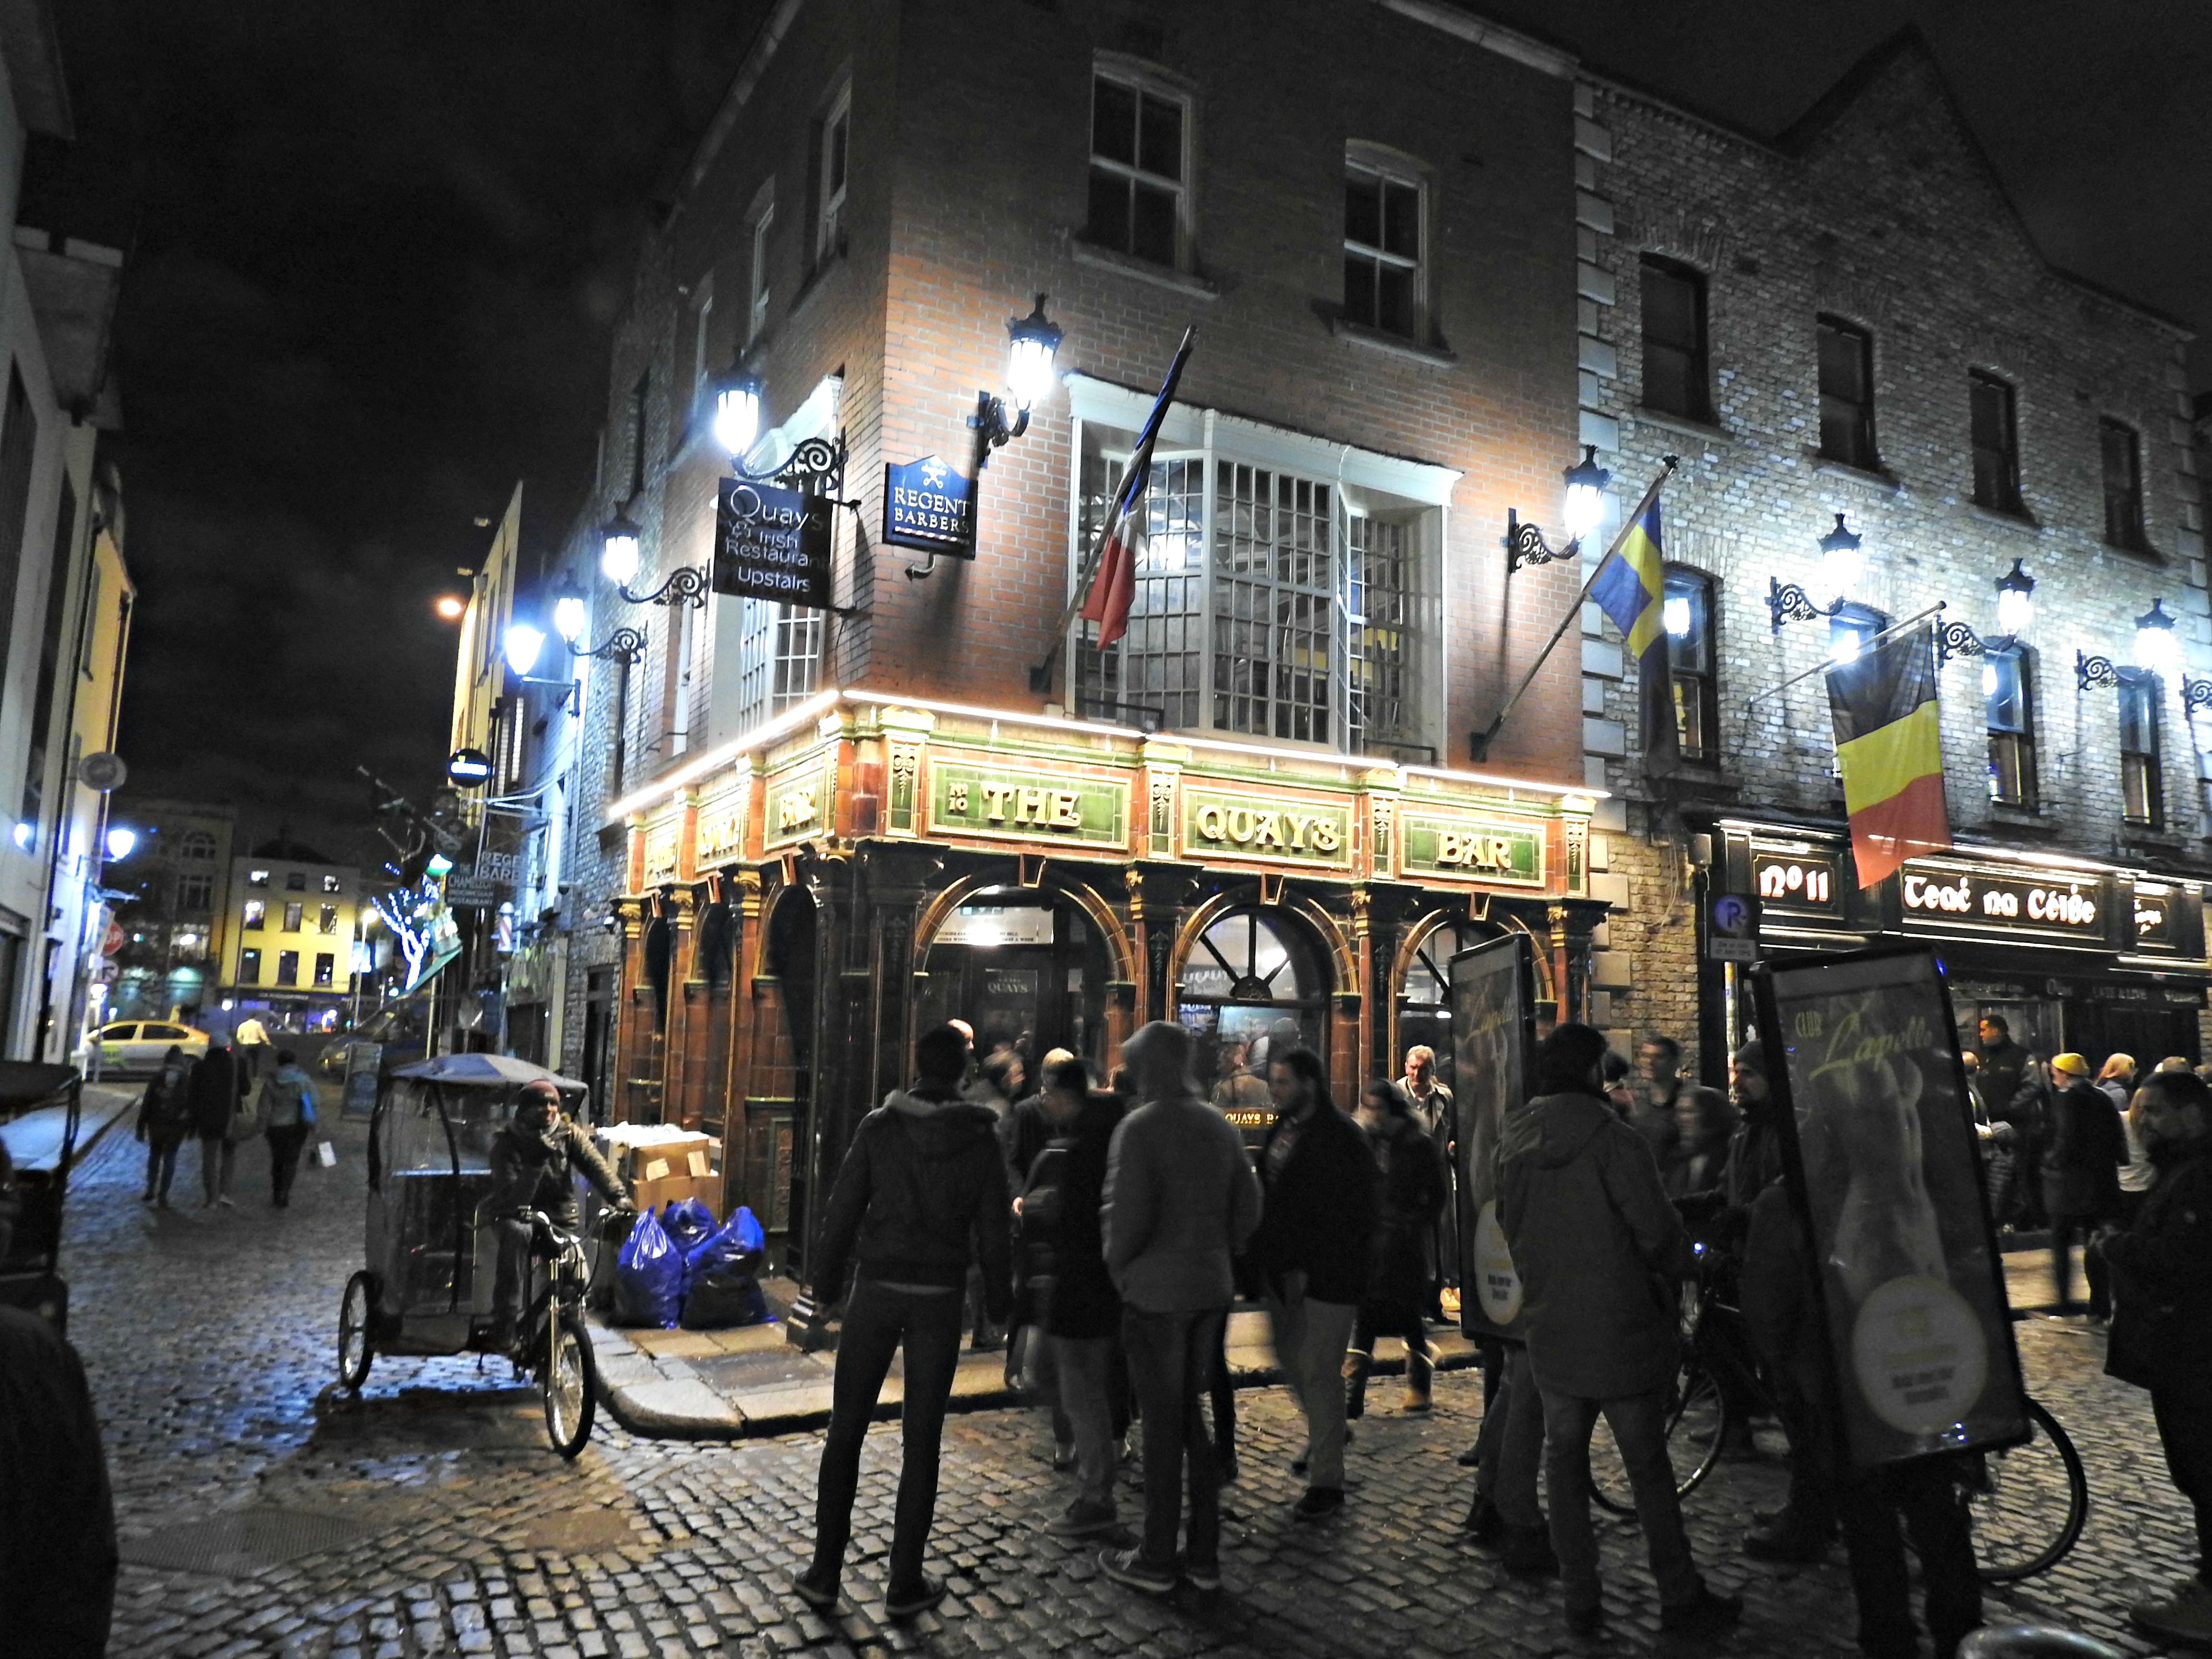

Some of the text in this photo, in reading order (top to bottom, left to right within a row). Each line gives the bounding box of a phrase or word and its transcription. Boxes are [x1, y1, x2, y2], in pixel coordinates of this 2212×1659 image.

[730, 484, 824, 531] Quays
[894, 486, 970, 517] REGENT
[894, 506, 969, 534] BARBERS
[759, 530, 798, 549] Irish
[738, 565, 811, 592] Upstairs
[948, 797, 968, 811] 10
[980, 781, 1081, 827] THE
[1197, 805, 1340, 851] QUAYS
[1436, 830, 1512, 870] BAR
[1983, 890, 2018, 917] na
